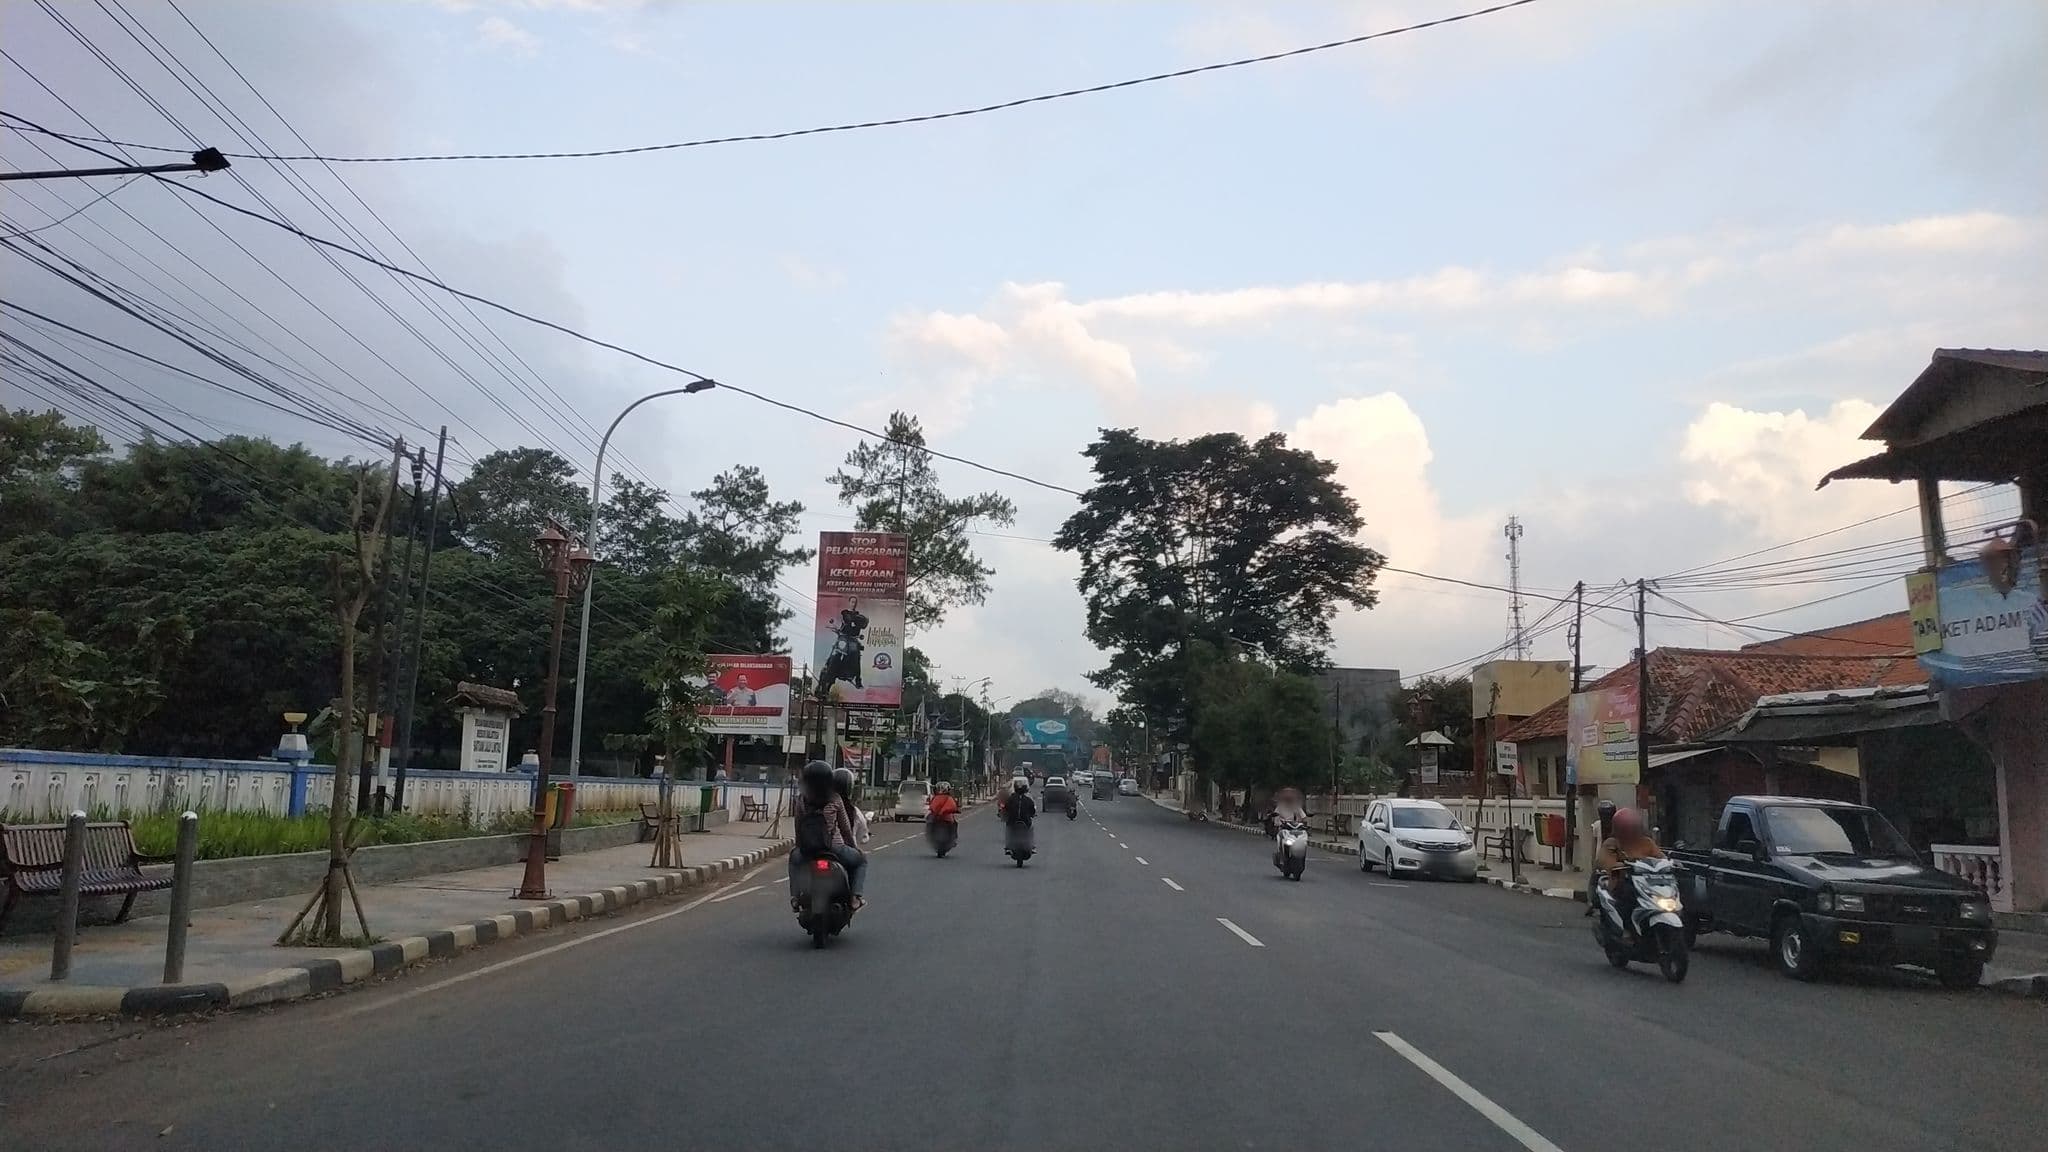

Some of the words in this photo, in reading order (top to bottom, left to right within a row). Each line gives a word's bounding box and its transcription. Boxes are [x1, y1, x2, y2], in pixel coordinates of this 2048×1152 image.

[851, 537, 877, 546] STOP
[825, 546, 901, 556] PELANGGARAN
[850, 559, 876, 568] STOP
[830, 568, 894, 578] KECELAKAAN
